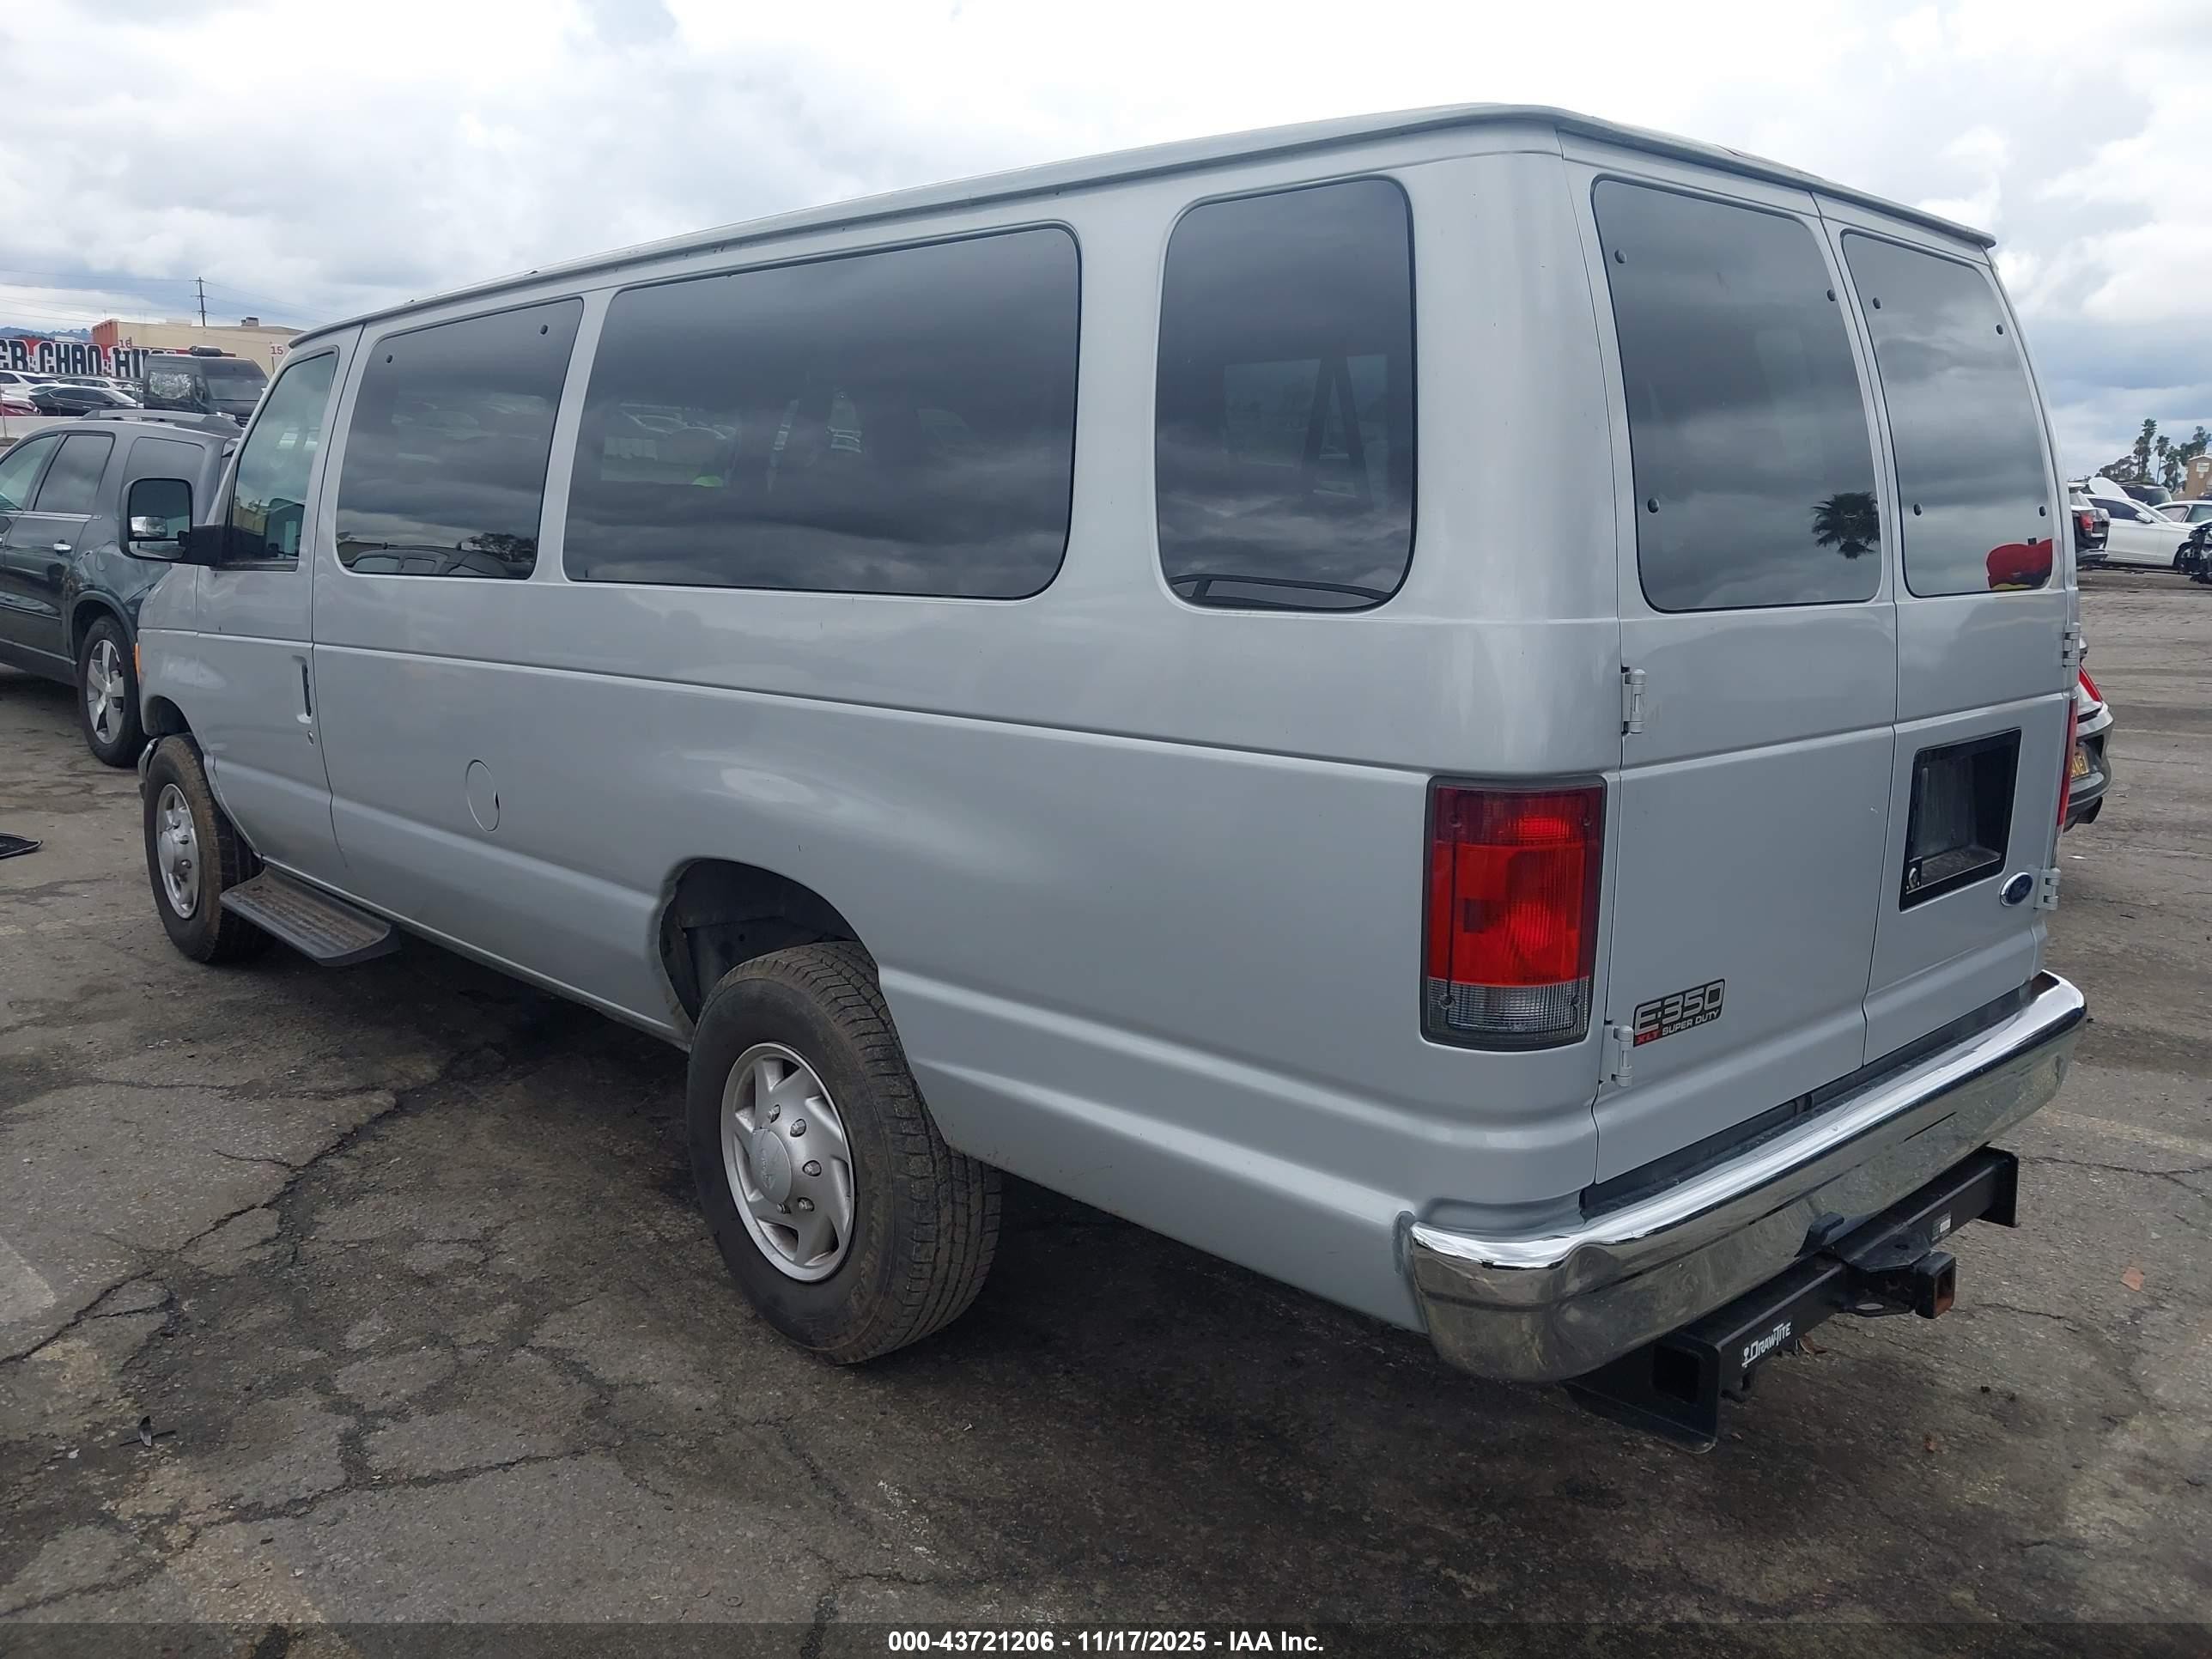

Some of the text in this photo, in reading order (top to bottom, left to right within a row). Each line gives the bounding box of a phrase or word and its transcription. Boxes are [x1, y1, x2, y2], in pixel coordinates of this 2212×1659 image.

[270, 345, 283, 355] 15
[1637, 1010, 1719, 1045] XLT SUPER DUTY
